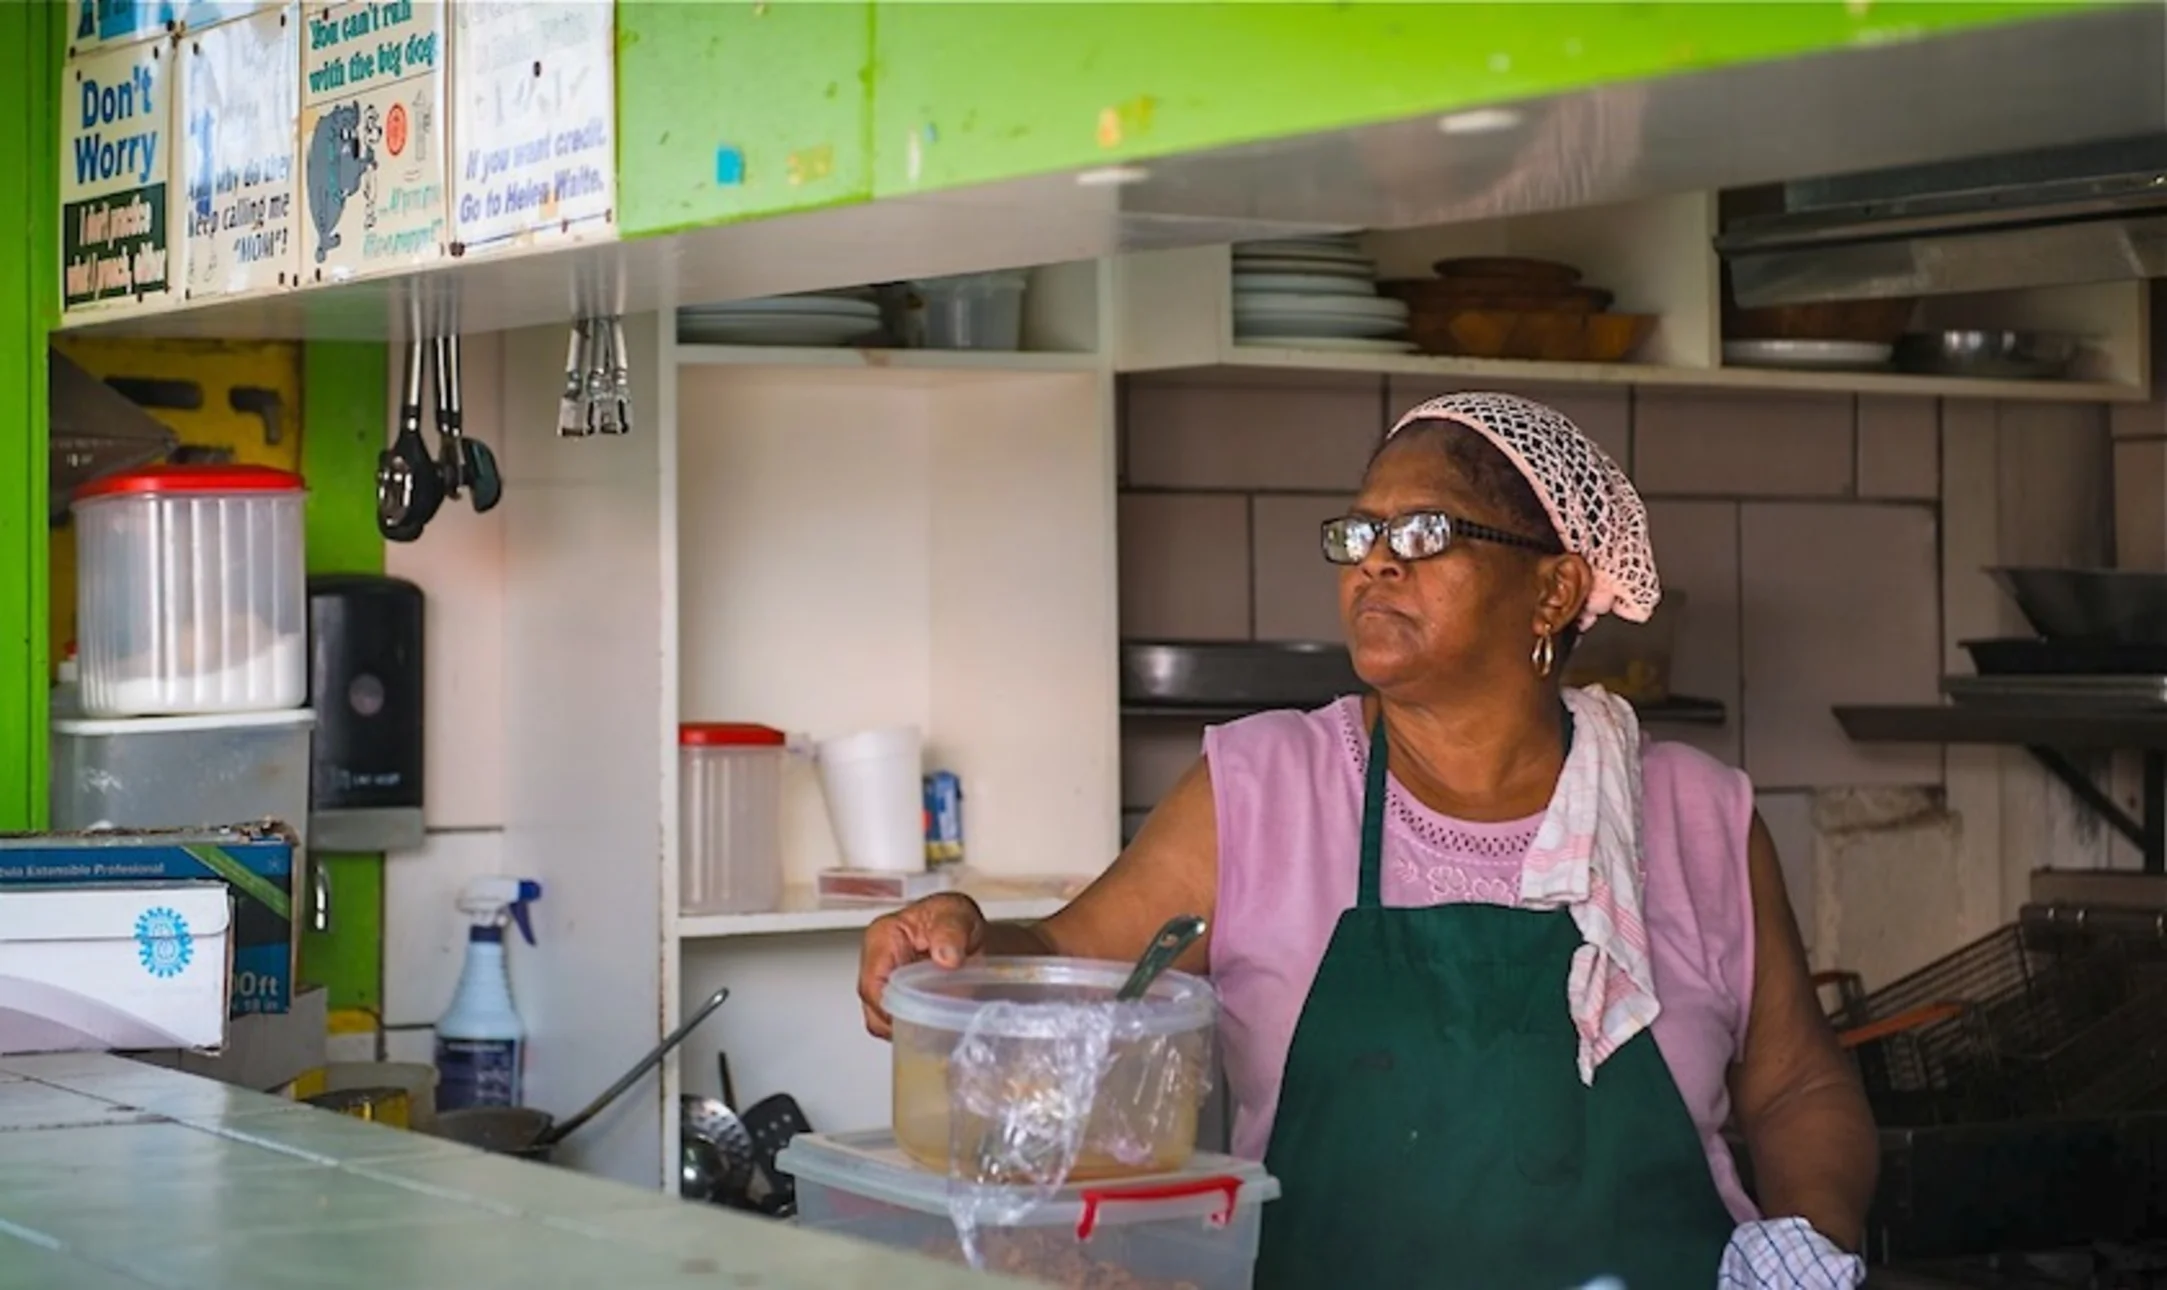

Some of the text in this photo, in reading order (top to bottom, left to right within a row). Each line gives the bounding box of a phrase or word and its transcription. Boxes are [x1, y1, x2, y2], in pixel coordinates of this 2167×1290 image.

[309, 0, 412, 50] You can't run
[309, 57, 346, 93] with
[348, 51, 375, 83] the
[377, 41, 402, 78] big
[81, 65, 153, 130] Don't
[75, 131, 158, 185] Worry
[481, 147, 510, 184] you
[513, 129, 550, 169] want
[268, 192, 291, 220] me
[460, 191, 481, 224] Go
[486, 187, 502, 219] to
[505, 178, 549, 214] Helen
